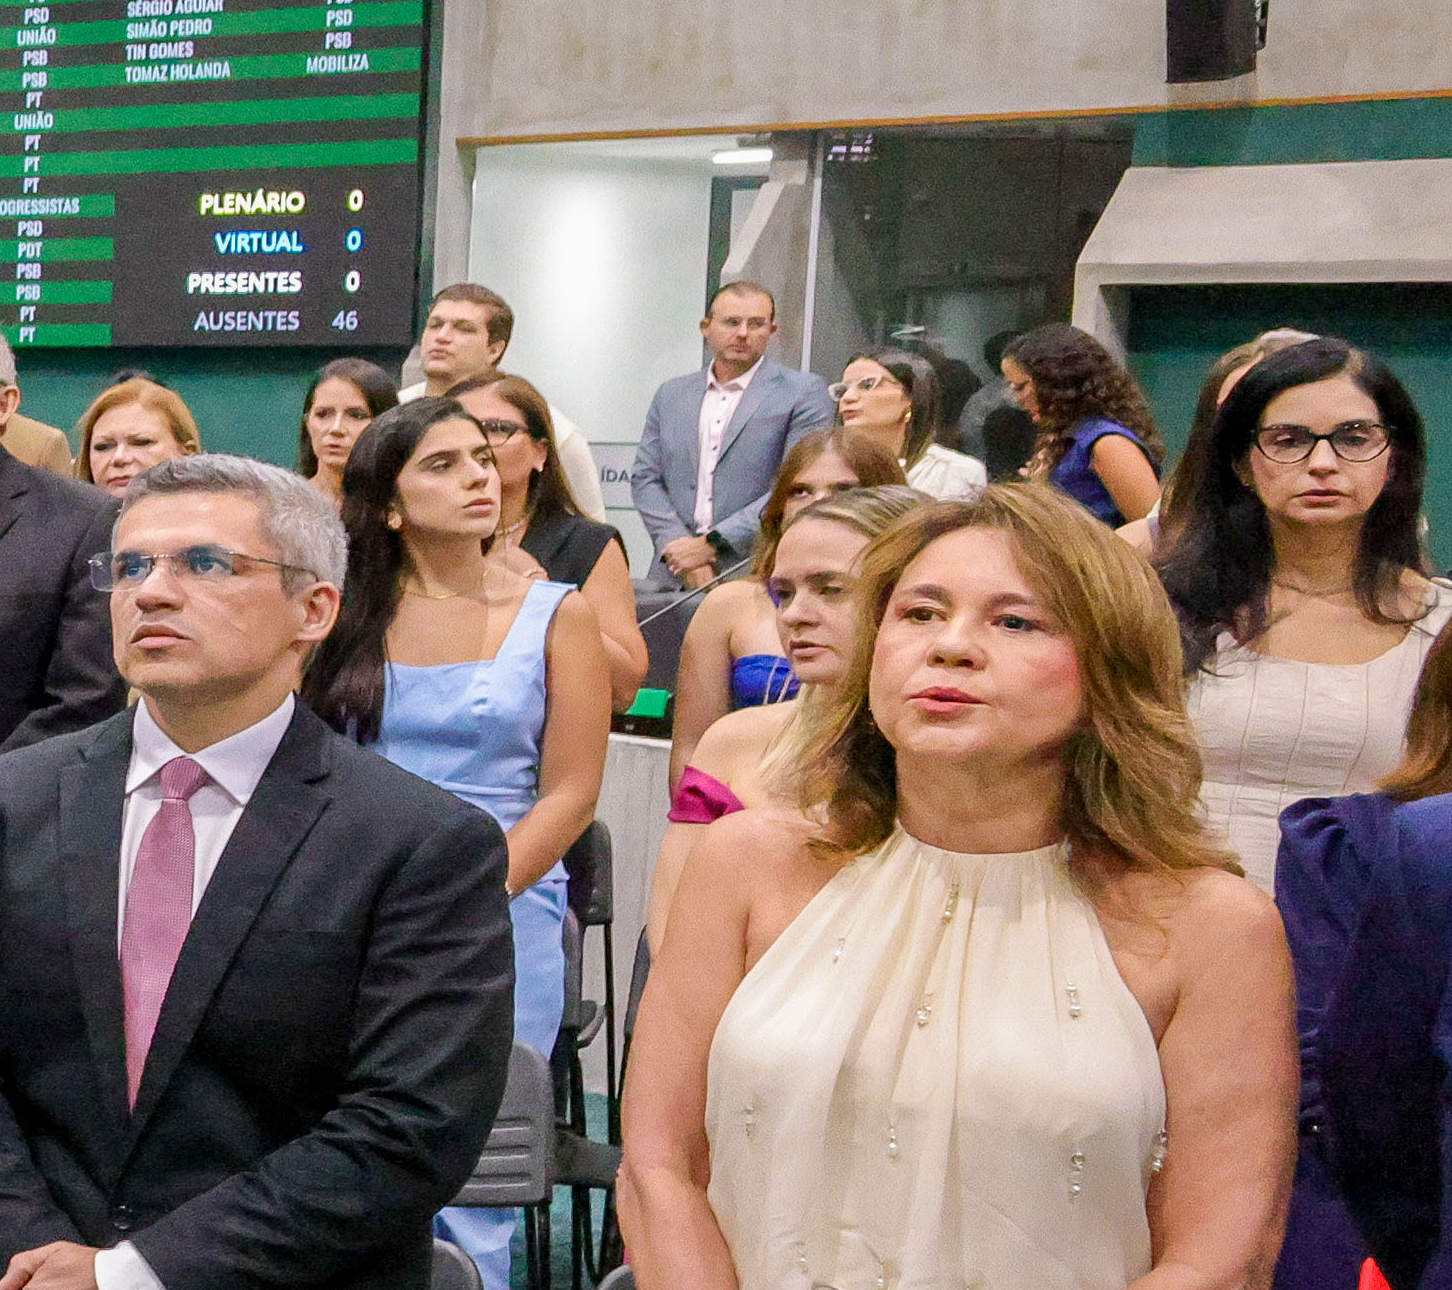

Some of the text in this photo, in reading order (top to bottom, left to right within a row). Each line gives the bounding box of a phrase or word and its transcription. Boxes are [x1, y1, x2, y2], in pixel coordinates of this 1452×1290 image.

[25, 8, 49, 24] PSD
[128, 0, 172, 17] SÉRGIO
[327, 10, 352, 26] PSD
[18, 27, 55, 45] UNIÃO
[128, 19, 212, 38] SIMÃO PEDRO
[326, 32, 351, 48] PSB
[24, 50, 47, 66] PSB
[307, 55, 368, 71] MOBILIZA
[23, 72, 47, 87] PSB
[126, 62, 230, 81] TOMAZ HOLANDA
[27, 92, 42, 107] PT
[15, 111, 53, 129] UNIÃO
[25, 135, 41, 150] PT
[25, 157, 39, 171] PT
[24, 178, 39, 193] PT
[201, 188, 363, 214] PLENÁRIO 0
[18, 221, 42, 236] PSD
[215, 229, 362, 253] VIRTUAL 0
[19, 242, 42, 257] PDT
[17, 263, 41, 278] PSB
[189, 271, 360, 293] PRESENTES 0
[17, 285, 40, 300] PSB
[20, 306, 36, 321] PT
[195, 311, 357, 330] AUSENTES 46
[20, 327, 35, 341] PT
[601, 465, 630, 483] ÍDA
